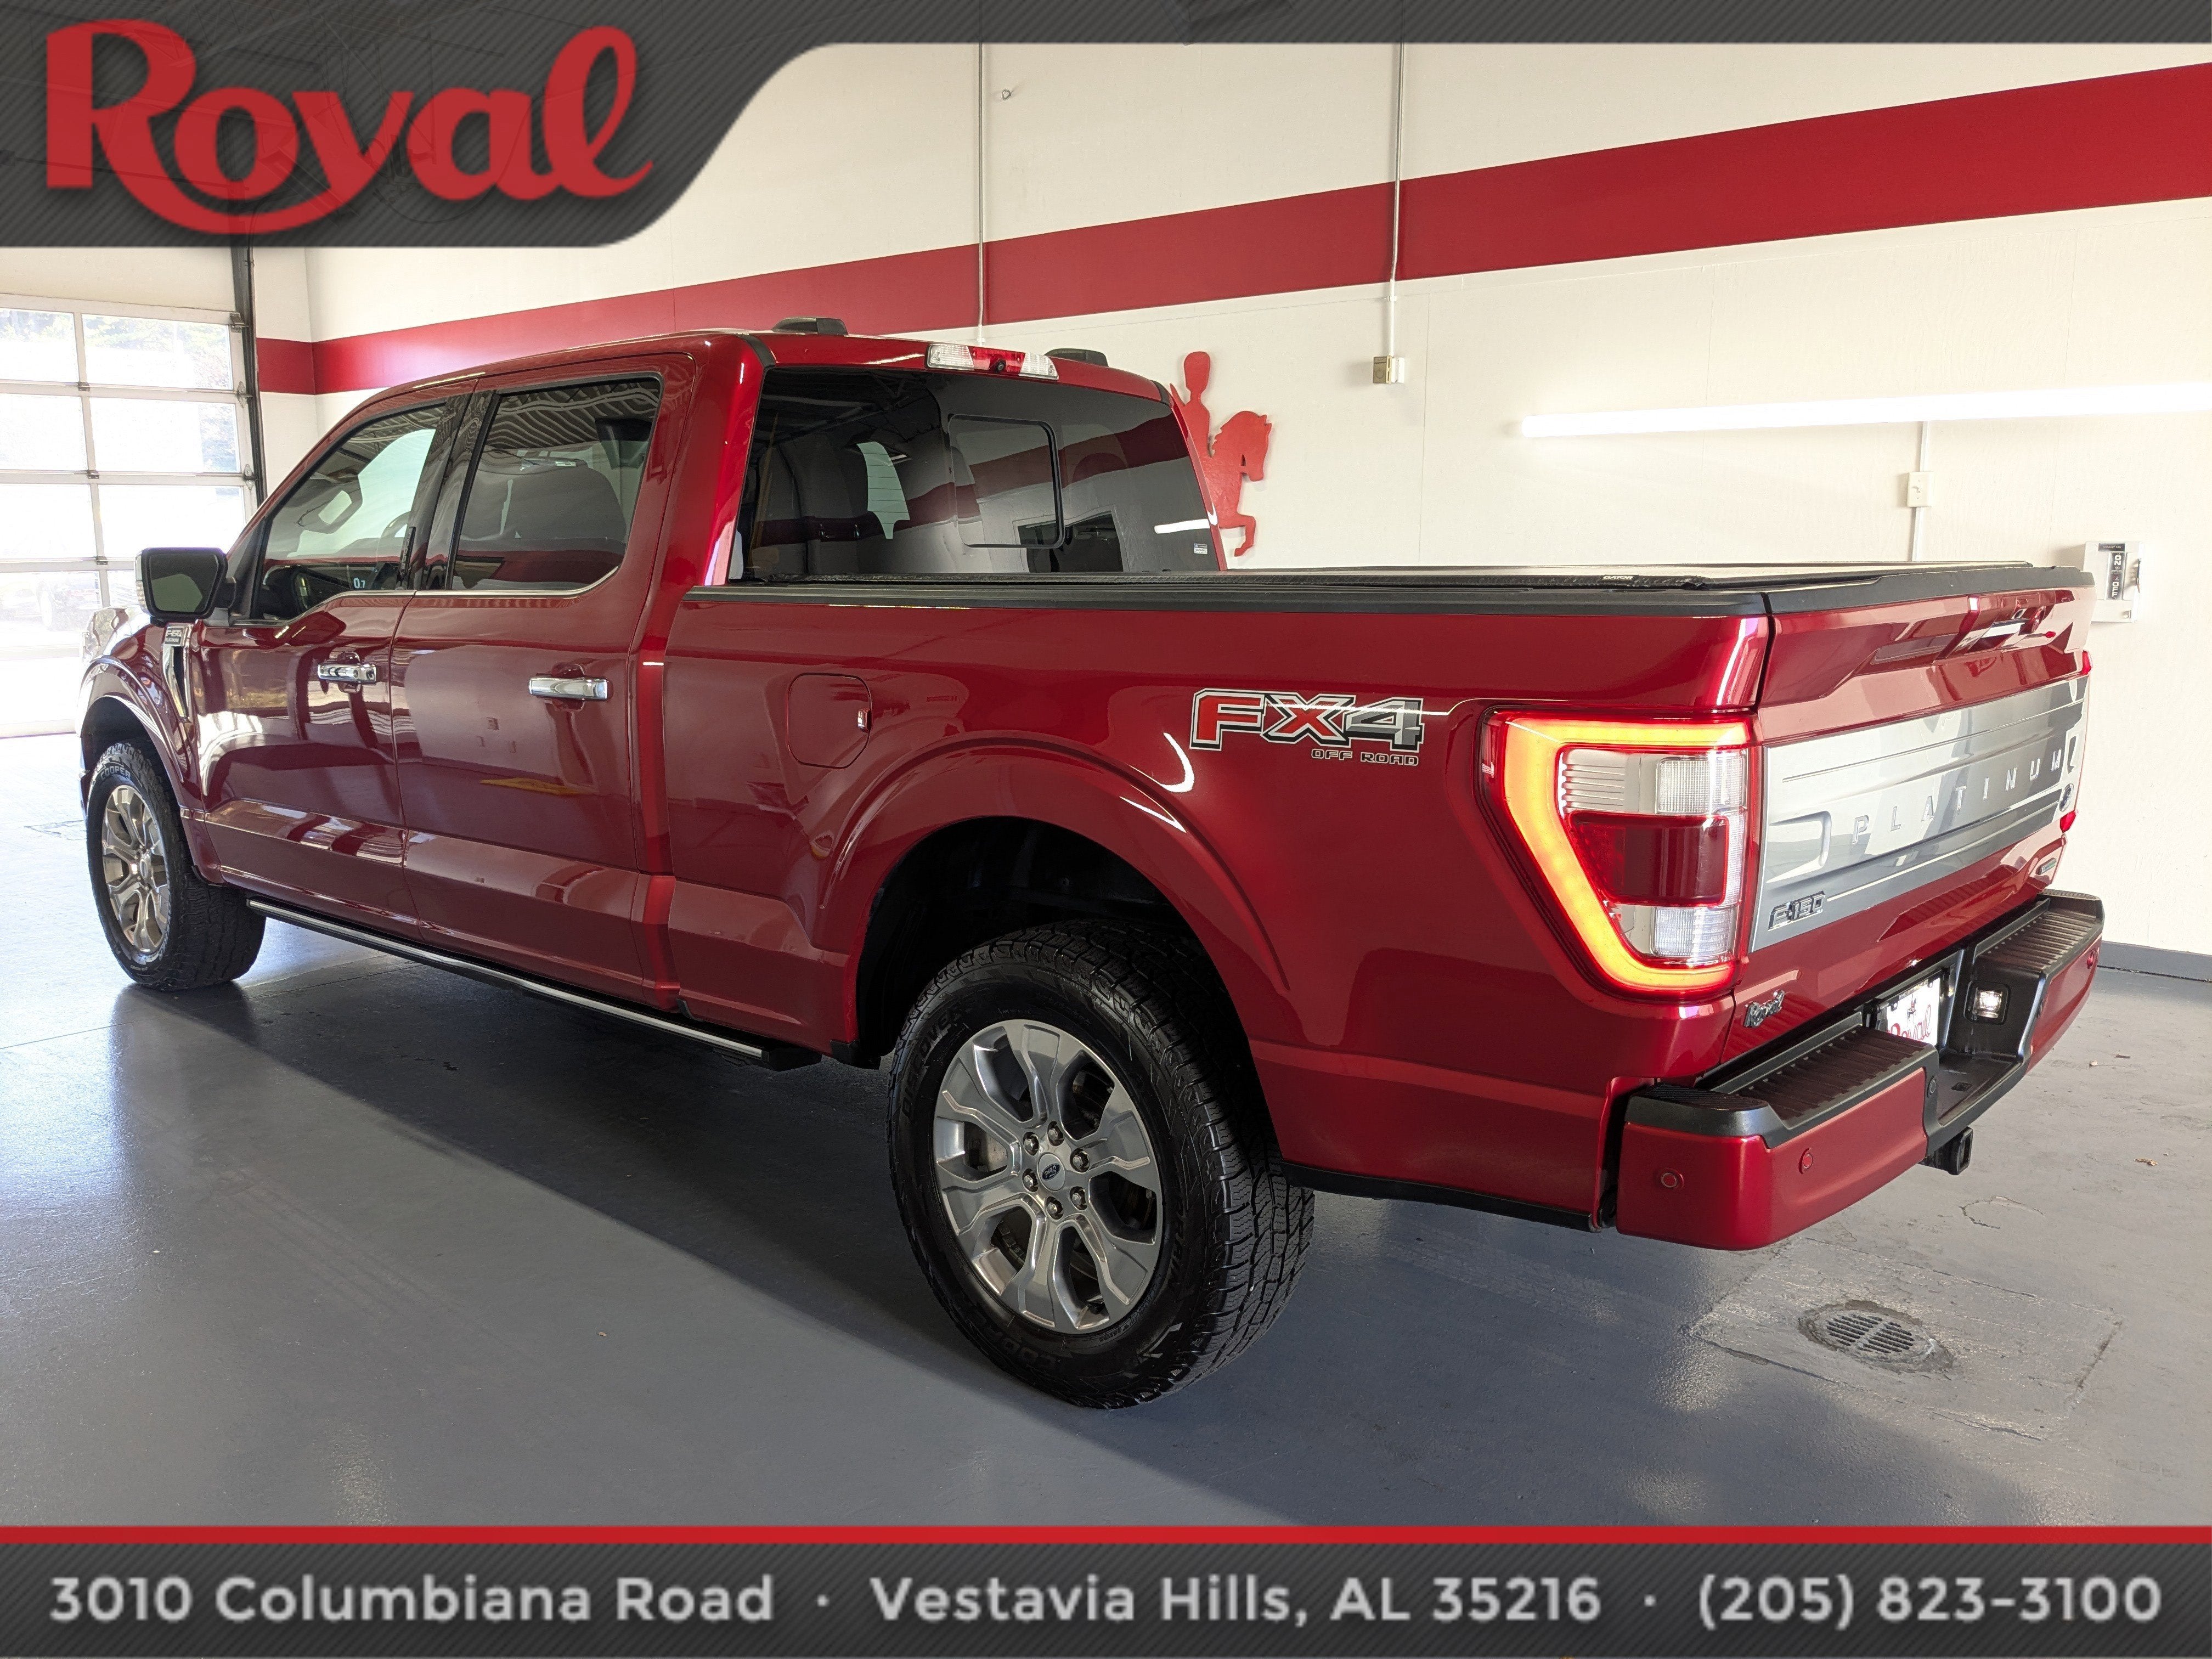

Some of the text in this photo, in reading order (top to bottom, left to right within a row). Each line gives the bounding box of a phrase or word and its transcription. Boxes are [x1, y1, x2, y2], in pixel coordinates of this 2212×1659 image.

[2114, 555, 2121, 566] ON
[353, 577, 366, 589] 0.7
[1189, 688, 1424, 752] FX4
[1311, 749, 1419, 766] OFF ROAD
[100, 765, 131, 781] COOPER
[1852, 748, 2062, 845] PLATINUM
[1768, 890, 1825, 931] F-150
